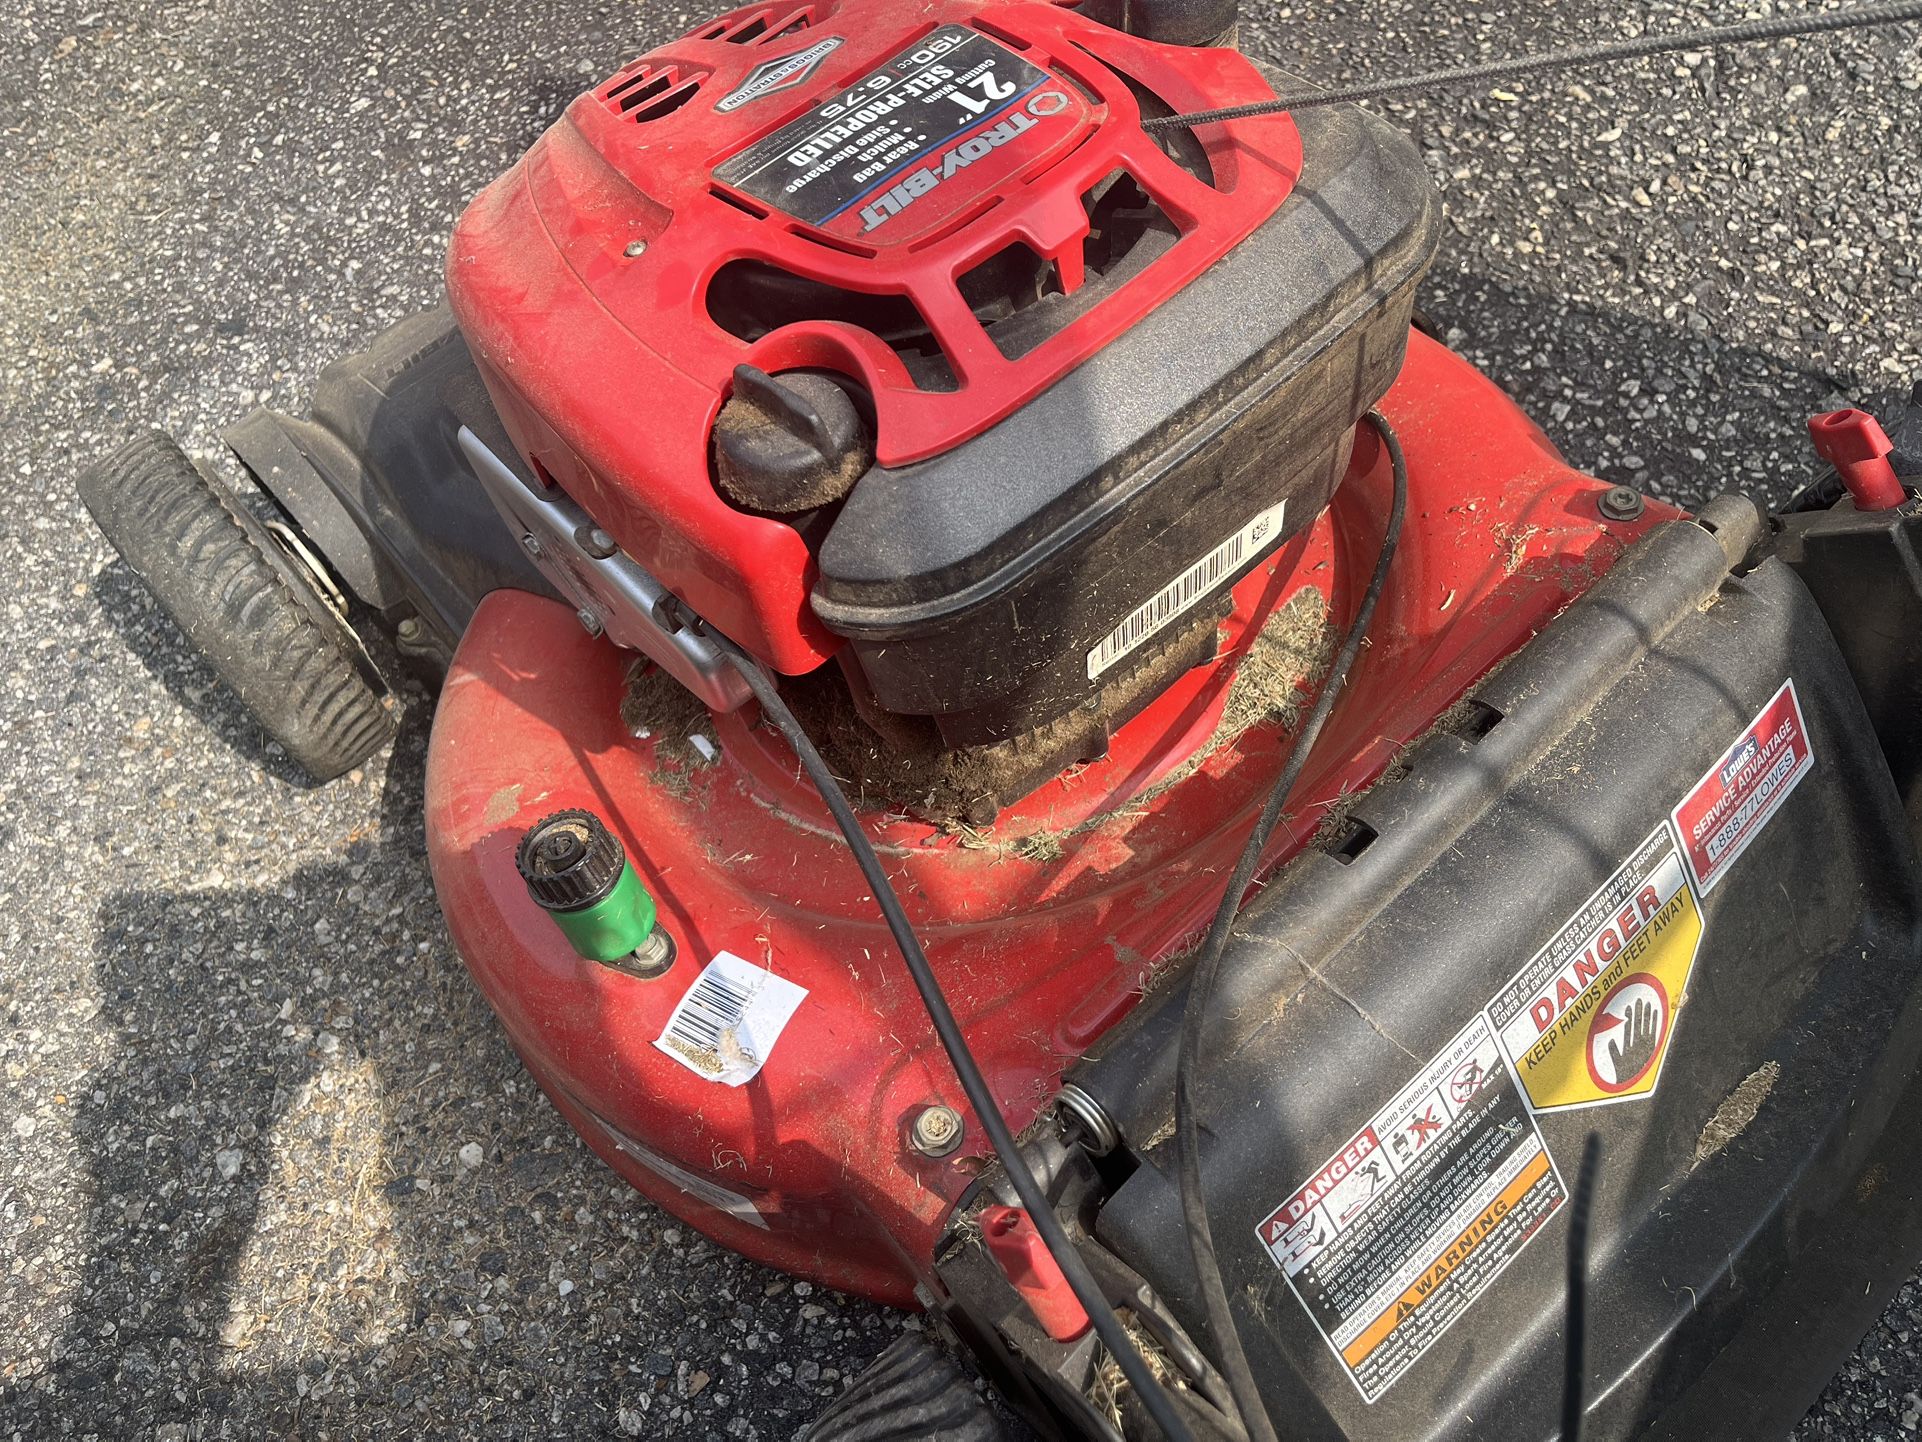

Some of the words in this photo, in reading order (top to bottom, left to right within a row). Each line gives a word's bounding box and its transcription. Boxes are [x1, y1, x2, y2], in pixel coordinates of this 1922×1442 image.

[784, 62, 955, 168] SELF-PROPELLED
[817, 73, 893, 119] 6.75
[920, 82, 957, 105] Width
[945, 70, 1020, 125] 21"
[954, 58, 996, 84] Cutting
[782, 145, 860, 193] Discharge
[850, 161, 887, 183] Bag
[854, 124, 891, 147] Side
[855, 132, 905, 162] Mulch
[857, 110, 1040, 231] TROY-BILT
[881, 140, 920, 163] Rear
[1692, 782, 1737, 842] SERVICE
[1736, 716, 1792, 791] ADVANTAGE
[1708, 751, 1793, 859] 1-888-77LOWES
[1722, 738, 1755, 784] LOWE'S
[1491, 1000, 1503, 1018] DO
[1502, 984, 1519, 1006] NOT
[1518, 951, 1551, 990] OPERATE
[1551, 922, 1579, 956] UNLESS
[1579, 911, 1590, 927] AN
[1590, 866, 1632, 916] UNDAMAGED
[1632, 828, 1668, 871] DISCHARGE
[1495, 997, 1519, 1027] COVER
[1519, 985, 1531, 1002] OR
[1530, 961, 1554, 991] ENTIRE
[1553, 939, 1575, 967] GRASS
[1574, 909, 1604, 945] CATCHER
[1604, 900, 1612, 913] IS
[1612, 892, 1620, 905] IN
[1620, 867, 1643, 897] PLACE.
[1529, 879, 1661, 1035] DANGER
[1524, 1027, 1559, 1071] KEEP
[1558, 982, 1601, 1036] HANDS
[1600, 959, 1622, 991] and
[1622, 928, 1652, 967] FEET
[1651, 891, 1685, 936] AWAY
[1376, 1110, 1399, 1136] AVOID
[1398, 1080, 1429, 1114] SERIOUS
[1427, 1057, 1452, 1085] INJURY
[1452, 1046, 1463, 1060] OR
[1462, 1024, 1485, 1051] DEATH
[1286, 1132, 1373, 1221] DANGER
[1311, 1248, 1330, 1270] KEEP
[1329, 1226, 1353, 1253] HANDS
[1352, 1212, 1368, 1230] AND
[1367, 1197, 1384, 1216] FEET
[1383, 1178, 1402, 1201] AWAY
[1401, 1159, 1422, 1182] FROM
[1420, 1128, 1452, 1163] ROTATING
[1451, 1106, 1475, 1132] PARTS.
[1316, 1247, 1346, 1279] REMOVE
[1344, 1221, 1374, 1252] OBJECTS
[1373, 1204, 1390, 1224] THAT
[1389, 1191, 1404, 1208] CAN
[1402, 1181, 1413, 1194] BE
[1412, 1155, 1440, 1186] THROWN
[1439, 1146, 1449, 1159] BY
[1448, 1133, 1461, 1150] THE
[1460, 1113, 1481, 1137] BLADE
[1480, 1106, 1488, 1118] IN
[1487, 1093, 1501, 1111] ANY
[1326, 1280, 1338, 1295] DO
[1337, 1267, 1353, 1285] NOT
[1352, 1249, 1370, 1270] MOW
[1370, 1230, 1390, 1253] WHEN
[1389, 1198, 1422, 1234] CHILDREN
[1421, 1189, 1432, 1202] OR
[1431, 1164, 1456, 1192] OTHERS
[1455, 1151, 1469, 1167] ARE
[1468, 1123, 1496, 1155] AROUND.
[1331, 1287, 1346, 1304] USE
[1345, 1267, 1367, 1291] EXTRA
[1366, 1240, 1395, 1271] CAUTION
[1393, 1230, 1405, 1244] ON
[1402, 1203, 1431, 1235] SLOPES.
[1430, 1194, 1440, 1208] DO
[1439, 1181, 1453, 1198] NOT
[1452, 1165, 1469, 1185] MOW
[1468, 1142, 1491, 1169] SLOPES
[1490, 1115, 1518, 1145] GRETER
[1335, 1291, 1354, 1313] THAN
[1366, 1262, 1384, 1283] MOW
[1383, 1237, 1410, 1266] ACROSS
[1409, 1217, 1430, 1240] NEVER
[1429, 1206, 1440, 1220] UP
[1438, 1193, 1453, 1211] AND
[1452, 1172, 1474, 1197] DOWN.
[1473, 1154, 1491, 1175] LOOK
[1490, 1135, 1510, 1158] DOWN
[1508, 1121, 1523, 1139] AND
[1320, 1247, 1358, 1287] DIRECTION.
[1357, 1229, 1378, 1252] WEAR
[1377, 1205, 1401, 1232] SAFETY
[1340, 1292, 1366, 1320] BEHIND
[1364, 1267, 1391, 1296] BEFORE
[1390, 1254, 1405, 1271] AND
[1404, 1233, 1426, 1258] WHILE
[1424, 1207, 1451, 1237] MOVING
[1449, 1168, 1489, 1211] BACKWARDS.
[1353, 1337, 1389, 1376] Operation
[1388, 1328, 1398, 1341] Of
[1398, 1313, 1415, 1332] This
[1414, 1277, 1451, 1318] Equipment
[1449, 1260, 1465, 1280] May
[1464, 1239, 1486, 1265] Create
[1485, 1216, 1509, 1244] Sparks
[1508, 1200, 1523, 1218] That
[1523, 1187, 1536, 1203] Can
[1535, 1170, 1551, 1189] Start
[1358, 1361, 1377, 1383] Fires
[1376, 1336, 1403, 1365] Around
[1402, 1323, 1417, 1341] Dry
[1415, 1286, 1453, 1328] Vegetation.
[1451, 1280, 1459, 1290] A
[1457, 1259, 1479, 1285] Spark
[1503, 1219, 1518, 1238] May
[1516, 1209, 1526, 1222] Be
[1526, 1178, 1556, 1213] Required.
[1362, 1372, 1378, 1391] The
[1409, 1318, 1434, 1346] Should
[1433, 1291, 1460, 1321] Contact
[1460, 1270, 1480, 1294] Local
[1479, 1257, 1492, 1274] Fire
[1492, 1227, 1522, 1261] Agencies
[1521, 1213, 1533, 1229] For
[1532, 1195, 1550, 1216] Laws
[1549, 1185, 1559, 1198] Or
[1415, 1196, 1508, 1297] WARNING
[1416, 1239, 1435, 1261] SAFETY
[1434, 1219, 1455, 1242] DEVICES
[1367, 1353, 1409, 1400] Regulations
[1407, 1345, 1418, 1358] To
[1417, 1331, 1432, 1349] Fire
[1431, 1296, 1466, 1335] Prevention
[1465, 1249, 1511, 1300] Requirements.
